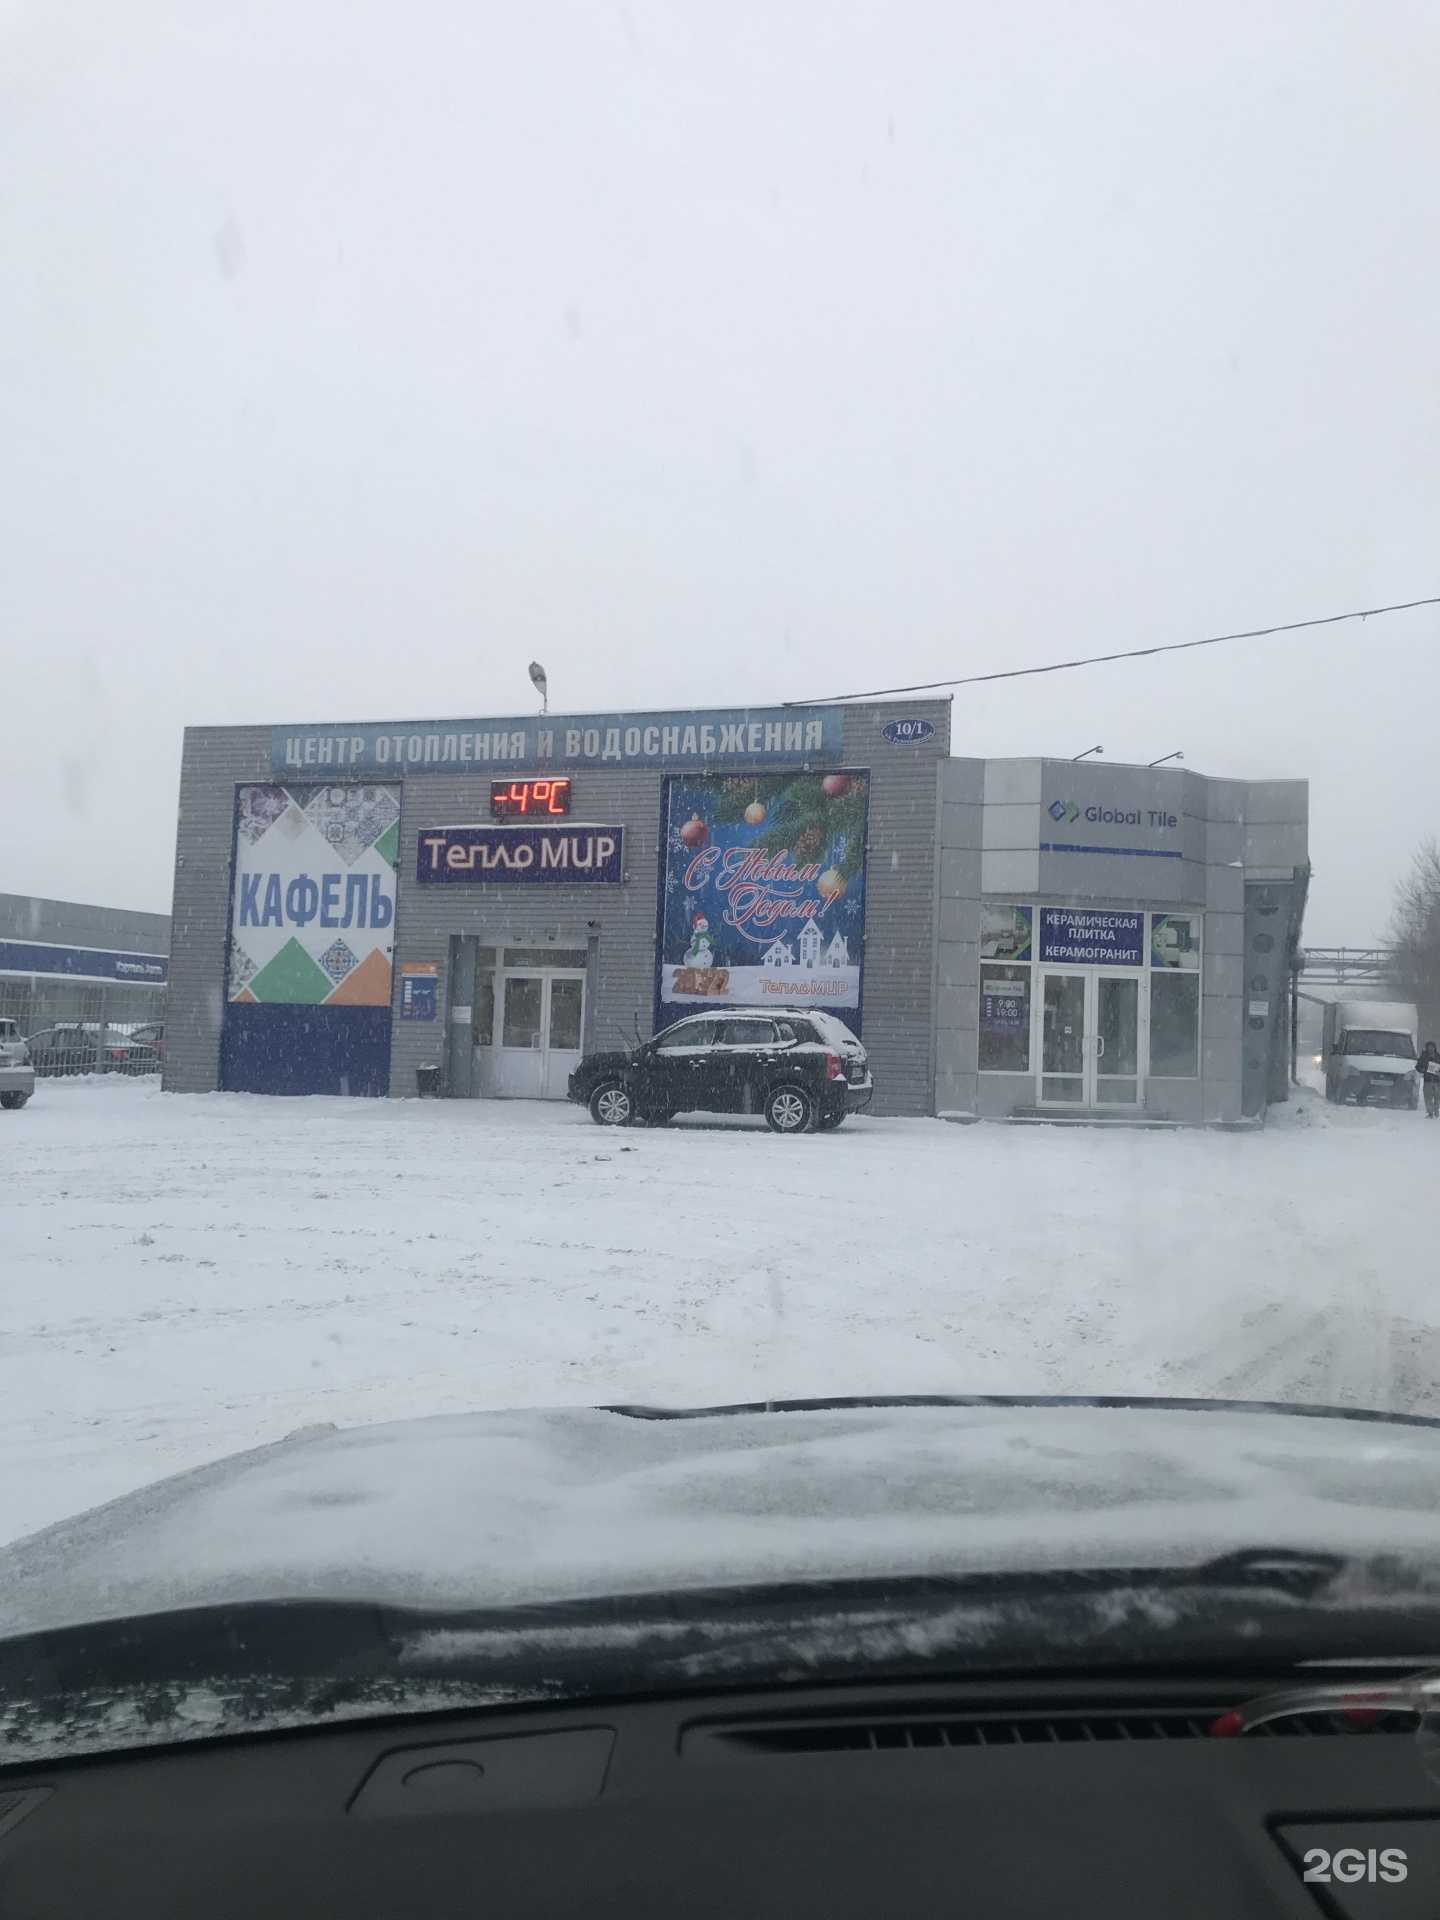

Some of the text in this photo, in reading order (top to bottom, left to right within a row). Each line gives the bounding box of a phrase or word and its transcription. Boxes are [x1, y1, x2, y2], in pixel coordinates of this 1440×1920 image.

[896, 721, 922, 736] 10/1
[285, 720, 824, 768] ЦЕНТР ОТОПЛЕНИЯ И ВОДОСНАБЖЕНИЯ
[1085, 806, 1178, 828] Global Tile
[716, 847, 822, 891] Новым
[239, 873, 393, 929] КАФЕЛЬ
[723, 882, 840, 944] Годом!
[1046, 914, 1138, 929] КЕРАМИЧЕСКАЯ
[1068, 928, 1116, 941] ПЛИТКА
[1045, 945, 1138, 960] КЕРАМОГРАНИТ
